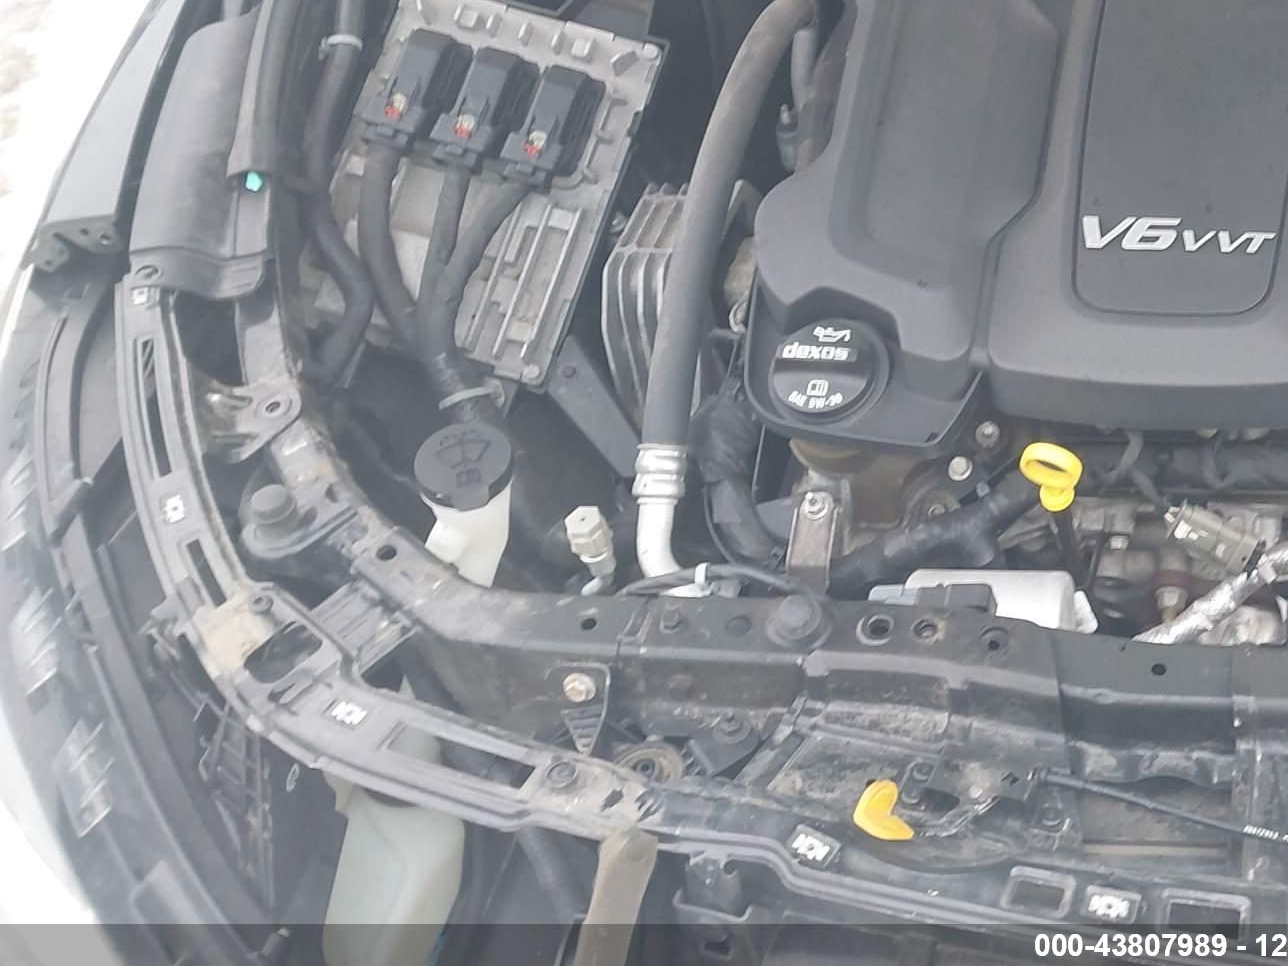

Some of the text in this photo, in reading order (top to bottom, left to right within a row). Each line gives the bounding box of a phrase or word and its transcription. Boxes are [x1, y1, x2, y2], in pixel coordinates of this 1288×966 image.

[1082, 215, 1278, 254] V6 VVT
[782, 341, 851, 361] dexos
